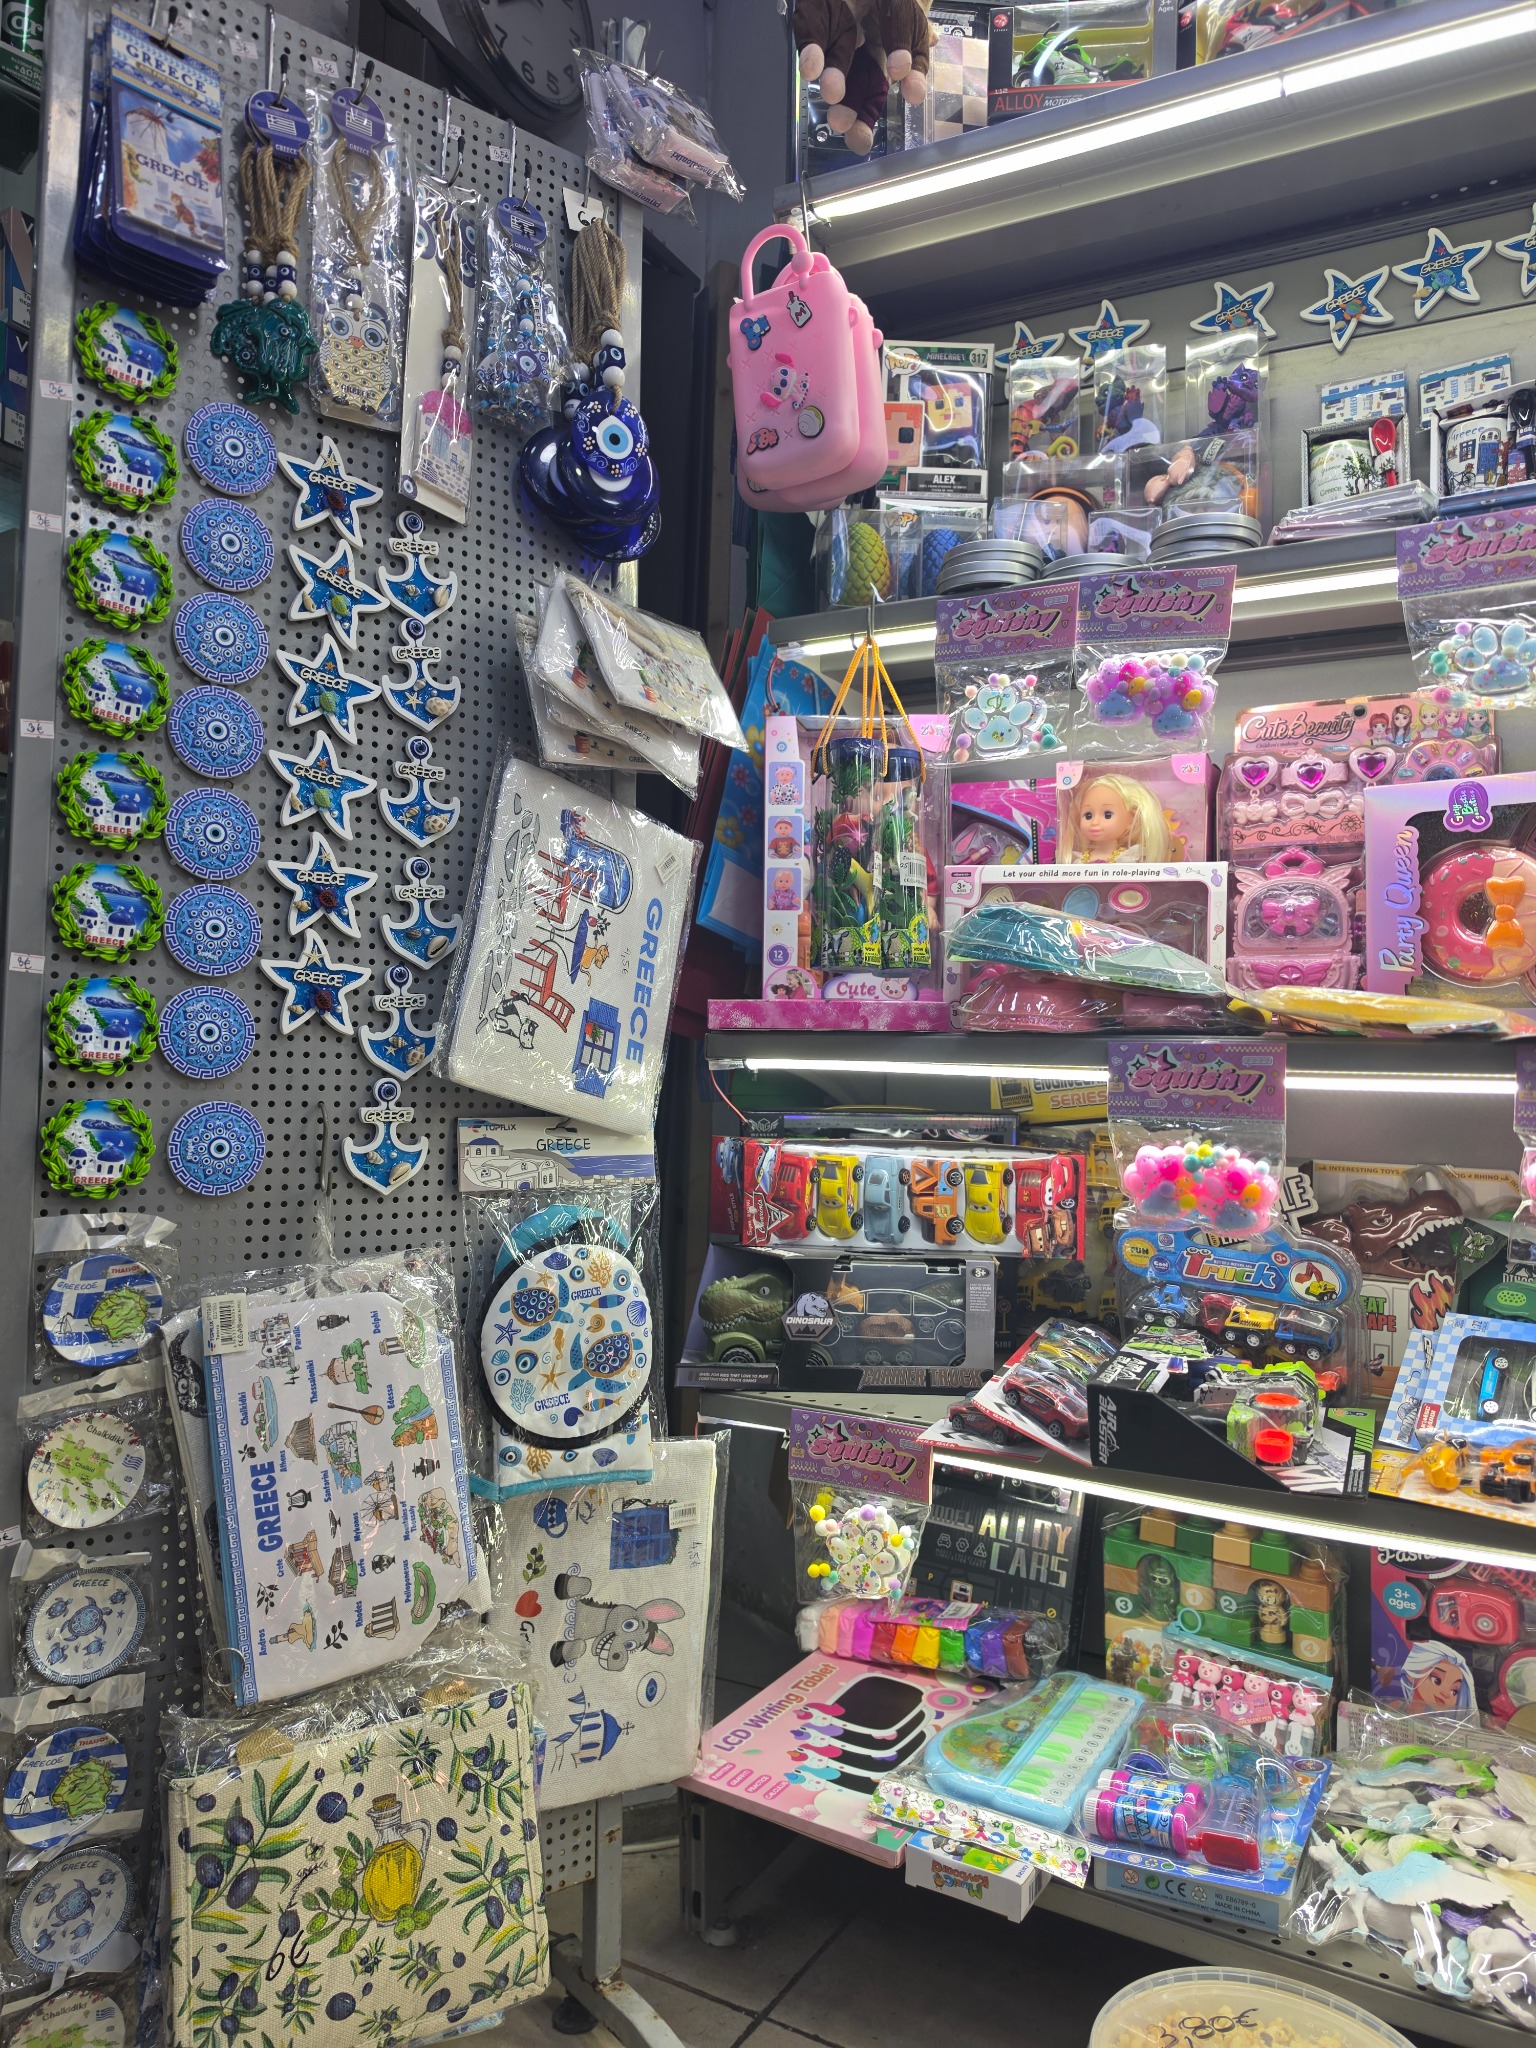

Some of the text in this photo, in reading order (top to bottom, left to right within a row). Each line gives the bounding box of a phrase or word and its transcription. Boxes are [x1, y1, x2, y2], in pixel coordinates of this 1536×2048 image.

[126, 44, 207, 94] GREECE
[520, 60, 534, 85] 6
[562, 63, 576, 83] 4
[546, 69, 560, 96] 5
[994, 93, 1044, 112] ALLOY
[275, 143, 298, 156] GREECE
[349, 143, 371, 157] GREECE
[135, 152, 209, 191] GREECE
[1420, 252, 1466, 276] GREECE
[1325, 283, 1367, 312] GREECE
[1215, 299, 1254, 325] GREECE
[1087, 327, 1125, 341] GREECE
[926, 351, 987, 365] MINECRAFT 317
[1008, 342, 1043, 361] GREECE
[105, 367, 144, 386] GREECE
[48, 383, 67, 397] 3€
[105, 479, 144, 496] GREECE
[309, 471, 357, 494] GREECE
[932, 474, 957, 485] ALEX
[1319, 485, 1343, 499] Greece
[37, 514, 51, 527] 3€
[392, 540, 438, 555] GREECE
[316, 566, 363, 599] GREECE
[98, 598, 137, 615] GREECE
[1096, 587, 1216, 620] Squishy
[953, 608, 1061, 641] Squishy
[397, 647, 441, 660] GREECE
[300, 667, 349, 692] GREECE
[92, 707, 131, 724] GREECE
[26, 722, 44, 735] 3€
[1242, 710, 1356, 747] Cute Beauty
[293, 764, 343, 788] GREECE
[399, 763, 445, 780] GREECE
[92, 823, 132, 836] GREECE
[296, 870, 345, 886] GREECE
[1003, 869, 1016, 878] Let
[1018, 870, 1037, 879] your
[1039, 868, 1059, 877] child
[1084, 869, 1099, 877] fun
[1112, 868, 1161, 878] role-playing
[400, 887, 445, 899] GREECE
[957, 882, 966, 890] 3+
[1380, 829, 1425, 972] Party Queen
[85, 934, 125, 947] GREECE
[17, 957, 33, 970] 3€
[773, 951, 783, 959] 12
[293, 969, 344, 987] GREECE
[626, 897, 664, 1065] GREECE
[836, 980, 877, 997] Cute
[379, 994, 427, 1009] GREECE
[81, 1050, 122, 1060] GREECE
[1130, 1066, 1265, 1099] Squishy
[1050, 1091, 1107, 1108] SERIES
[364, 1109, 413, 1122] GREECE
[484, 1123, 517, 1132] TOPFLIX
[536, 1138, 591, 1151] GREECE
[1329, 1166, 1376, 1174] INTERESTING
[73, 1176, 115, 1185] GREECE
[1130, 1246, 1149, 1256] FUN
[111, 1264, 141, 1275] THASSOS
[1183, 1248, 1278, 1289] Truck
[570, 1286, 602, 1301] GREECE
[370, 1310, 382, 1335] Delphi
[786, 1316, 834, 1326] DINOSAUR
[293, 1325, 302, 1350] Paralia
[304, 1360, 318, 1404] Thessaloniki
[861, 1367, 984, 1388] CARRIER TRUCK
[387, 1384, 396, 1410] Edessa
[534, 1392, 571, 1412] GREECE
[240, 1391, 249, 1426] Chalkidiki
[86, 1424, 126, 1445] Chalkidiki
[1098, 1393, 1109, 1465] BLASTER
[279, 1450, 288, 1473] Athens
[810, 1437, 915, 1475] Squishy
[324, 1470, 332, 1503] Santorini
[250, 1460, 284, 1553] GREECE
[353, 1512, 361, 1542] Mykonos
[400, 1500, 411, 1541] Mountains of
[409, 1505, 417, 1534] Thessaly
[978, 1508, 1072, 1555] ALLOY
[359, 1557, 367, 1577] Corfu
[989, 1541, 1071, 1588] CARS
[72, 1579, 110, 1588] GREECE
[1190, 1591, 1198, 1603] 1
[1394, 1588, 1410, 1599] 3+
[1118, 1598, 1130, 1611] 3
[1222, 1598, 1234, 1611] 2
[1388, 1597, 1417, 1610] ages
[355, 1600, 363, 1628] Rhodes
[259, 1628, 268, 1656] Andros
[1304, 1643, 1316, 1655] 4
[714, 1662, 838, 1754] LCD Writing Tablet
[79, 1736, 109, 1746] THASSOS
[61, 1860, 100, 1872] GREECE
[931, 1859, 990, 1889] Keyboard
[943, 1873, 983, 1900] Music
[1215, 1901, 1233, 1911] MADE
[1242, 1908, 1261, 1918] CHINA
[1226, 1896, 1257, 1909] EB6789-G
[42, 2001, 89, 2022] Chalkidiki
